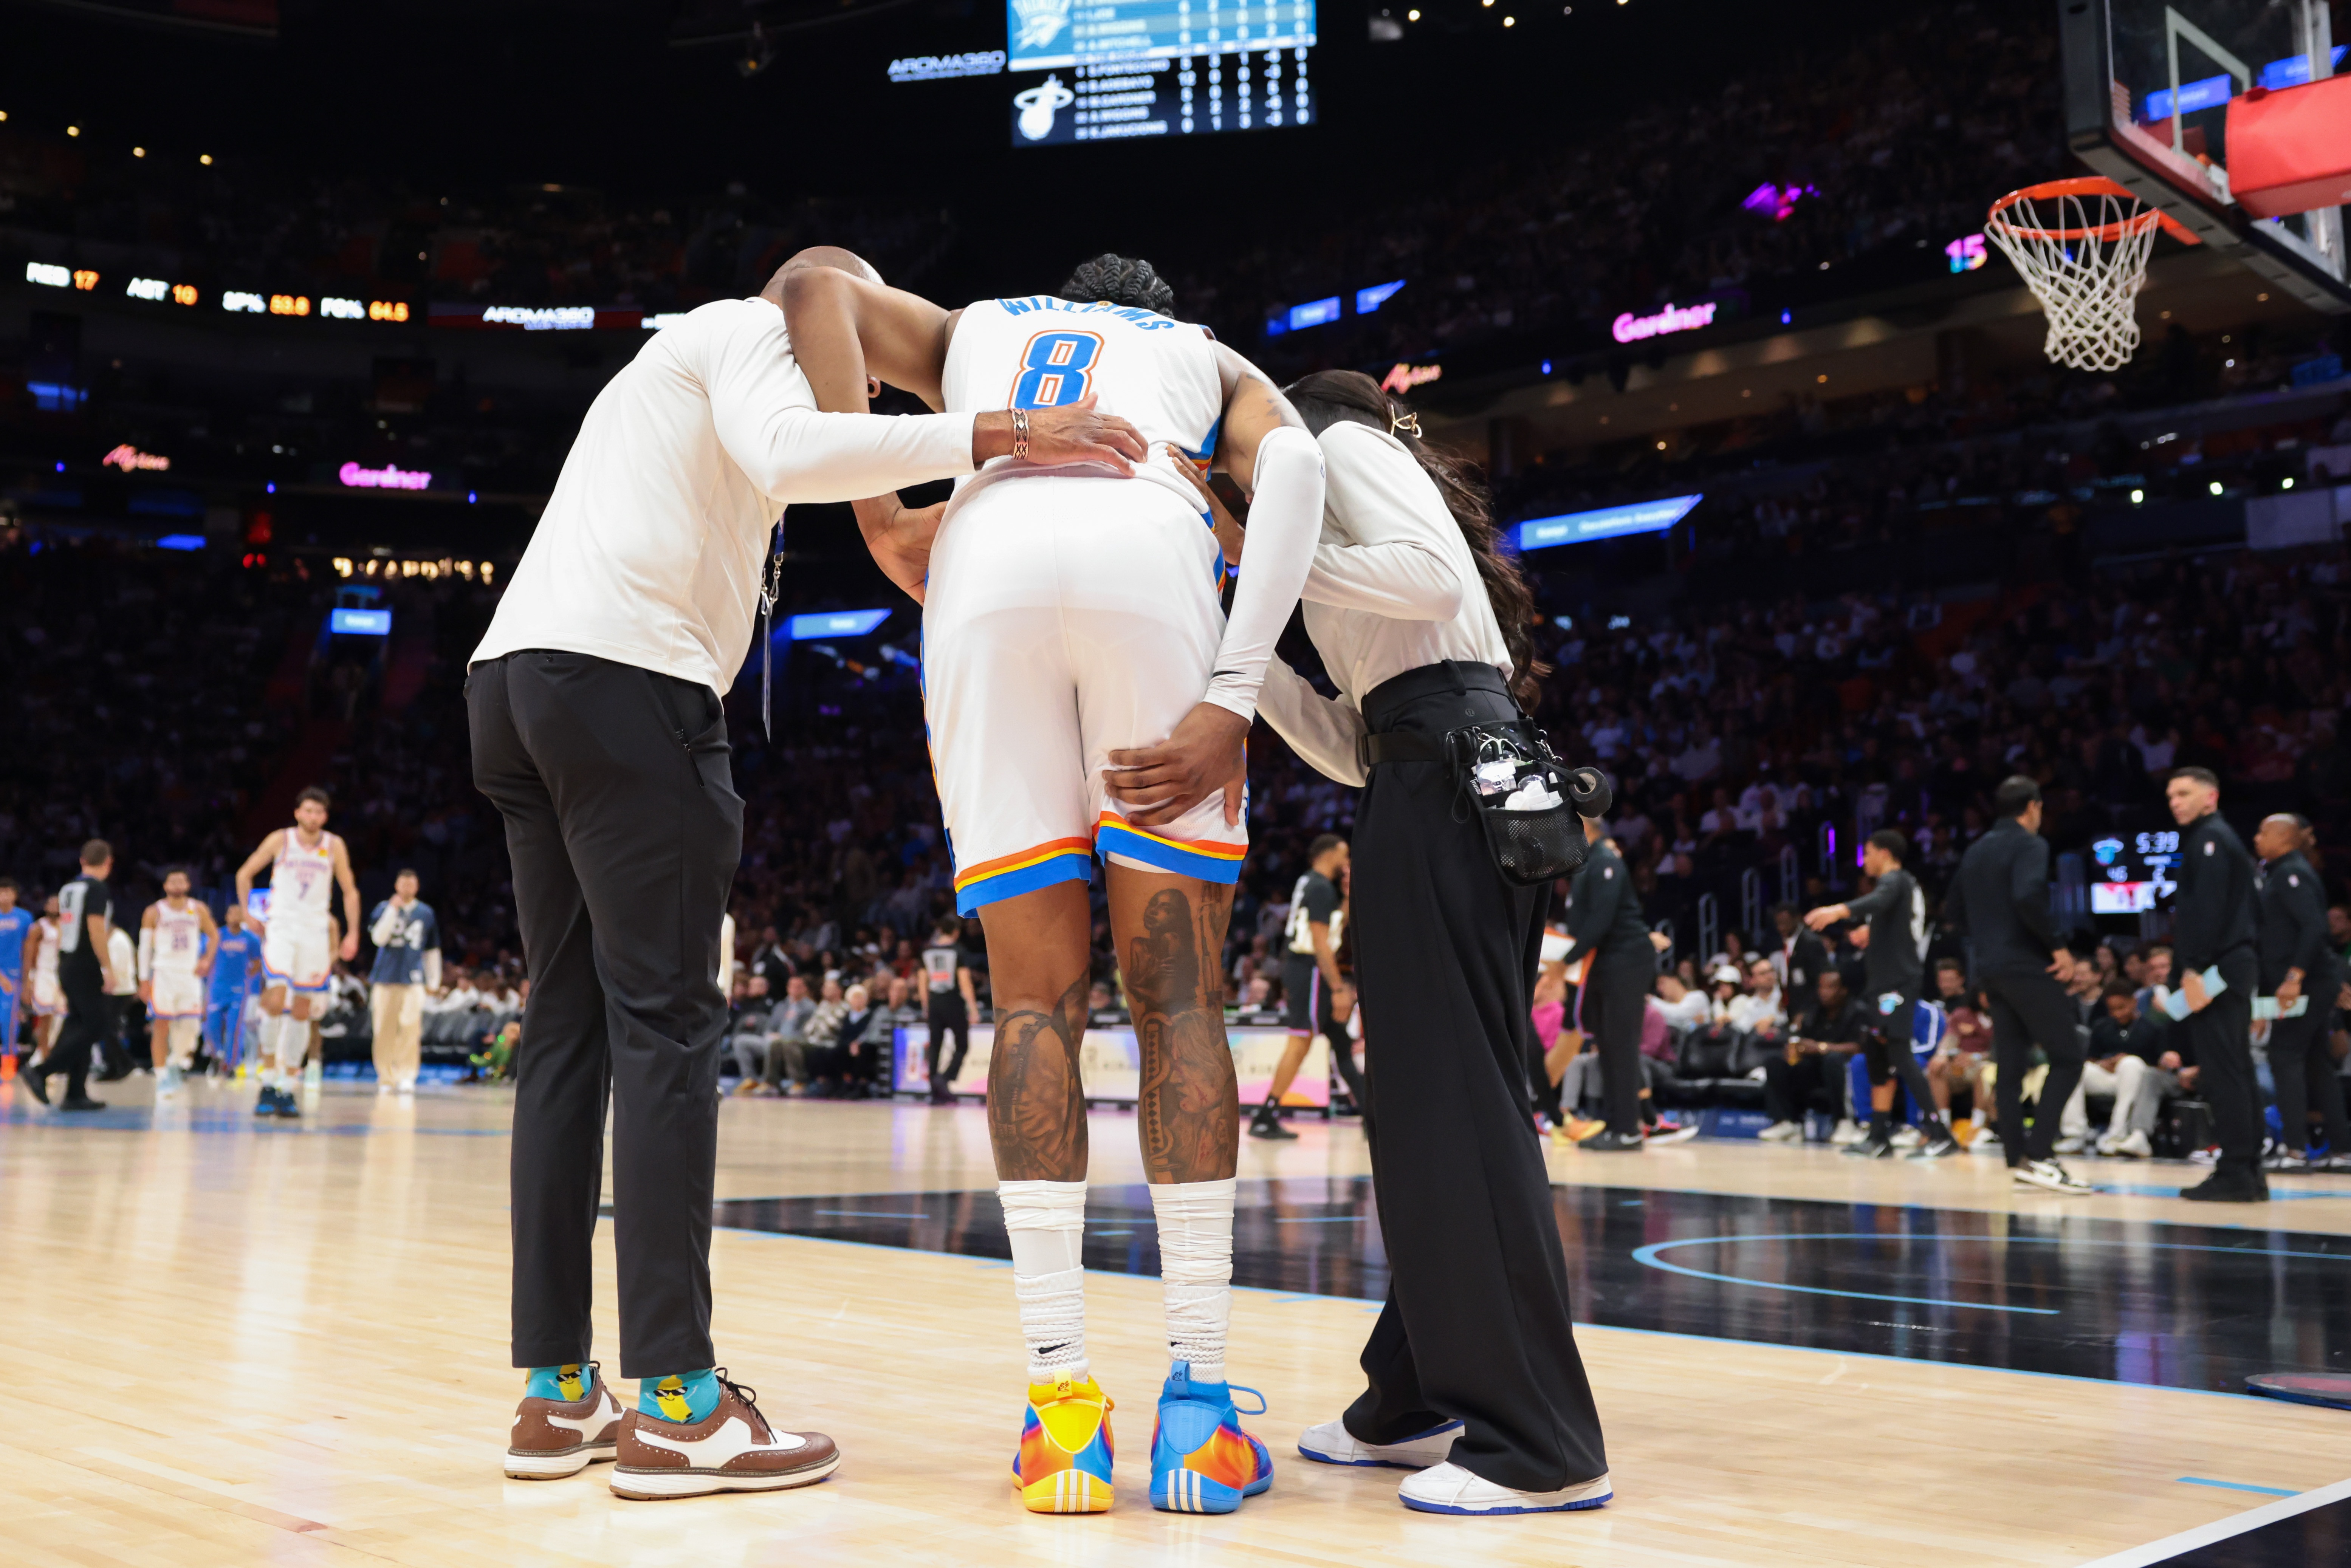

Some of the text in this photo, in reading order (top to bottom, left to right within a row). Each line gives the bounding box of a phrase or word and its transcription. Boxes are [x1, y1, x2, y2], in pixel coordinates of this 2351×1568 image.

[1944, 232, 1987, 273] 15
[73, 269, 99, 290] 17
[172, 284, 197, 305] 10
[995, 297, 1175, 330] WILLIAMS
[1613, 302, 1716, 343] Gardner
[1008, 330, 1105, 410] 8
[339, 462, 431, 489] Gardner
